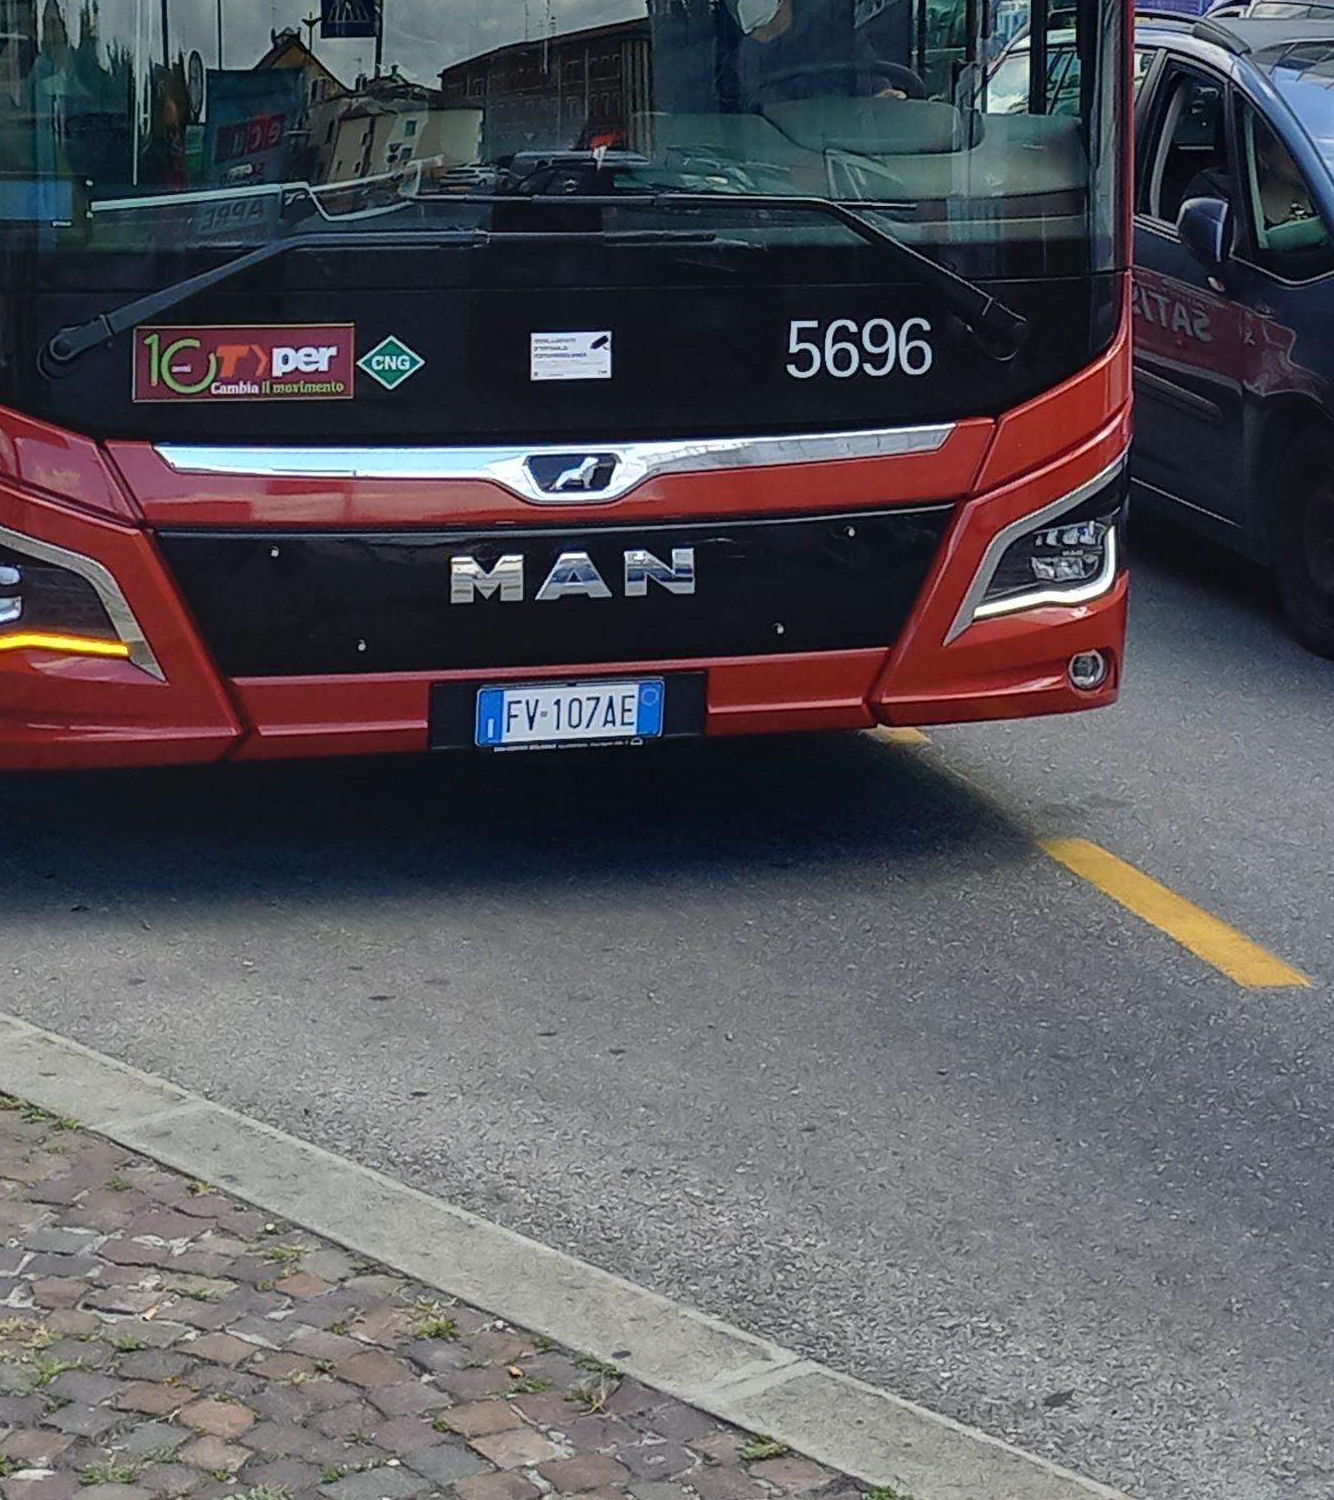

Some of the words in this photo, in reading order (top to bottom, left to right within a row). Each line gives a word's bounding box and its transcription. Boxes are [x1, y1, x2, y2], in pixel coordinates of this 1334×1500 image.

[371, 355, 411, 371] CNG
[786, 317, 933, 379] 5696
[210, 381, 259, 395] Cambia
[261, 380, 270, 393] il
[272, 380, 345, 394] movimento
[450, 548, 696, 604] MAN
